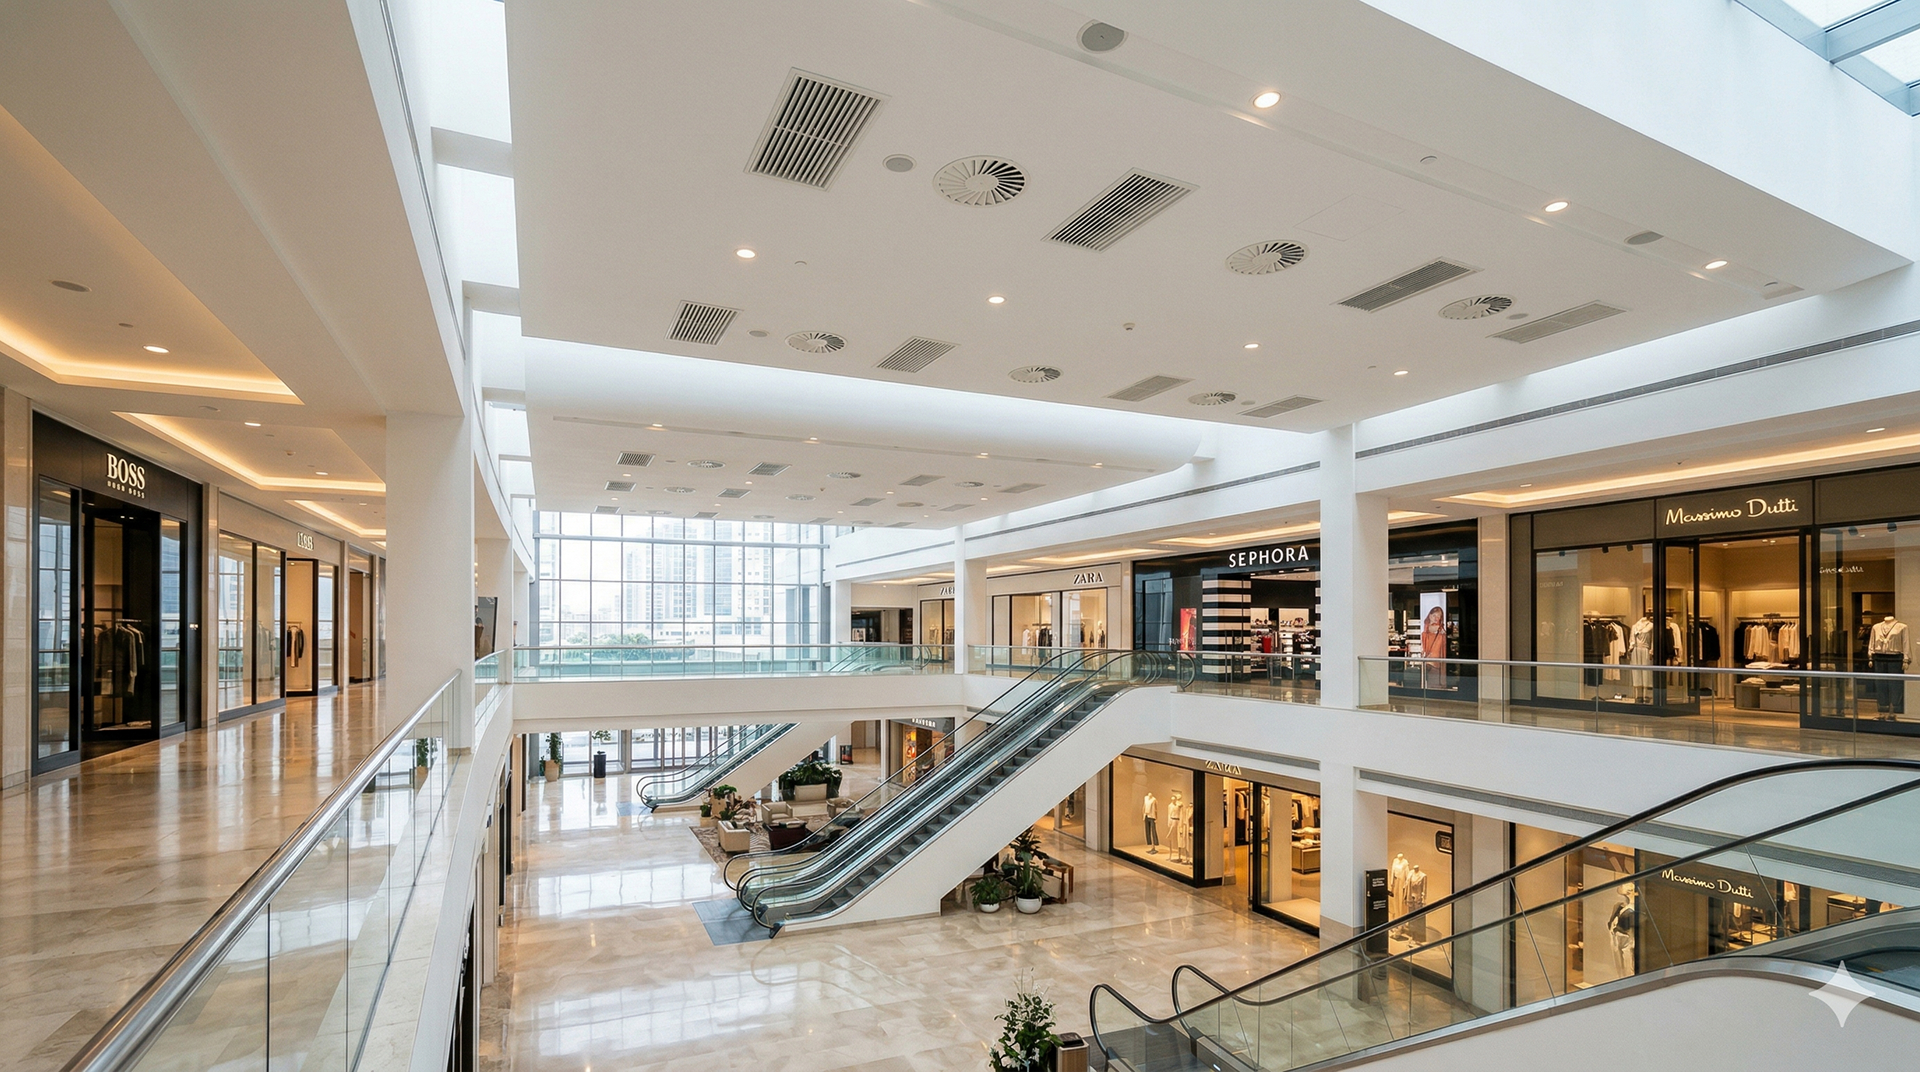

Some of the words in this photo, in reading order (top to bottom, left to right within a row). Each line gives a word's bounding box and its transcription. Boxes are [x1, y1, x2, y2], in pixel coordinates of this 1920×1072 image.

[107, 453, 146, 490] BOSS
[1665, 507, 1742, 526] Massimo
[1746, 498, 1799, 518] Dutti
[1228, 545, 1310, 568] SEPHORA
[1073, 571, 1104, 585] ZARA
[1661, 868, 1716, 890] Massimo
[1716, 878, 1755, 899] Dutti
